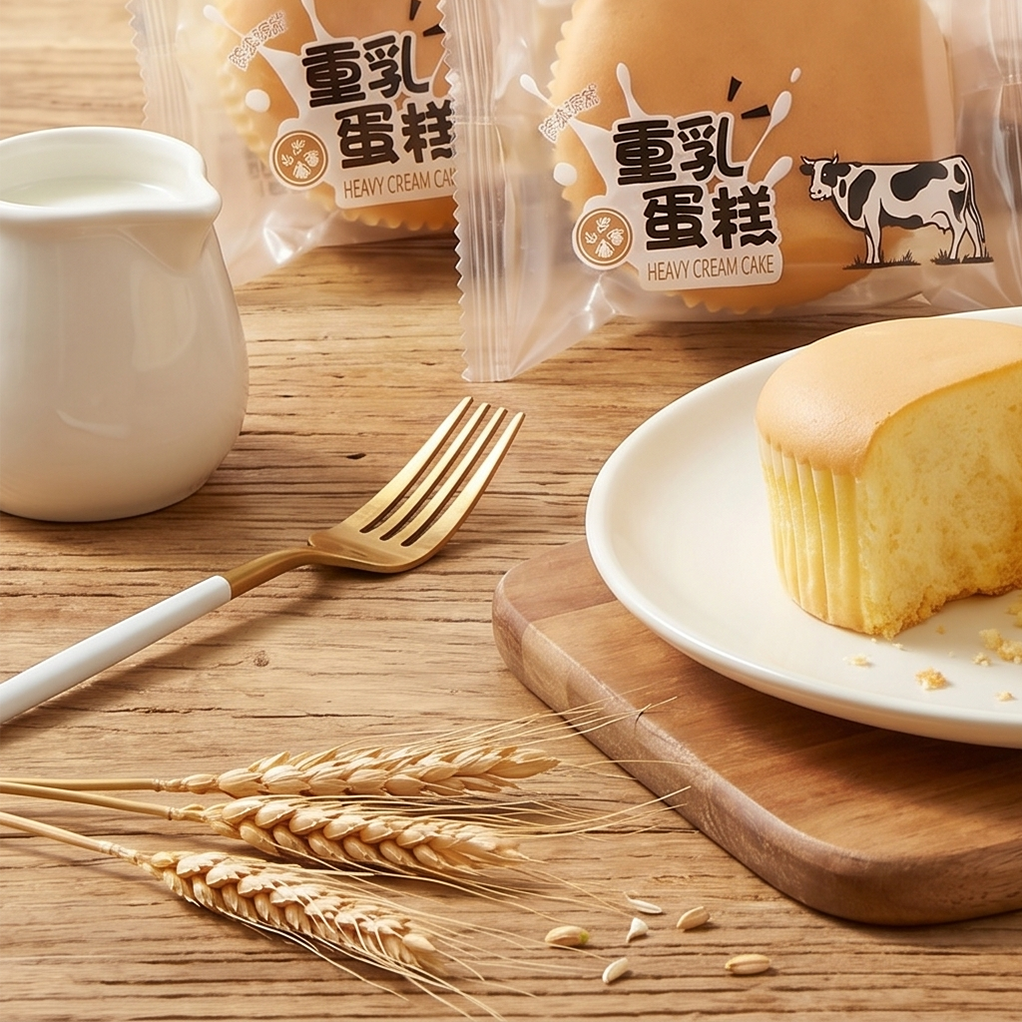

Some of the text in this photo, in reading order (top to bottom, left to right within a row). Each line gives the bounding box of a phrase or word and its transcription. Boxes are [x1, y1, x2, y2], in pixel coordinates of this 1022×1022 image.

[302, 35, 429, 108] 重乳
[335, 99, 455, 169] 蛋糕
[613, 115, 744, 185] 重乳
[344, 176, 385, 199] HEAVY
[387, 171, 431, 194] CREAM
[643, 185, 777, 250] 蛋糕
[648, 254, 774, 281] HEAVY CREAM CAKE
